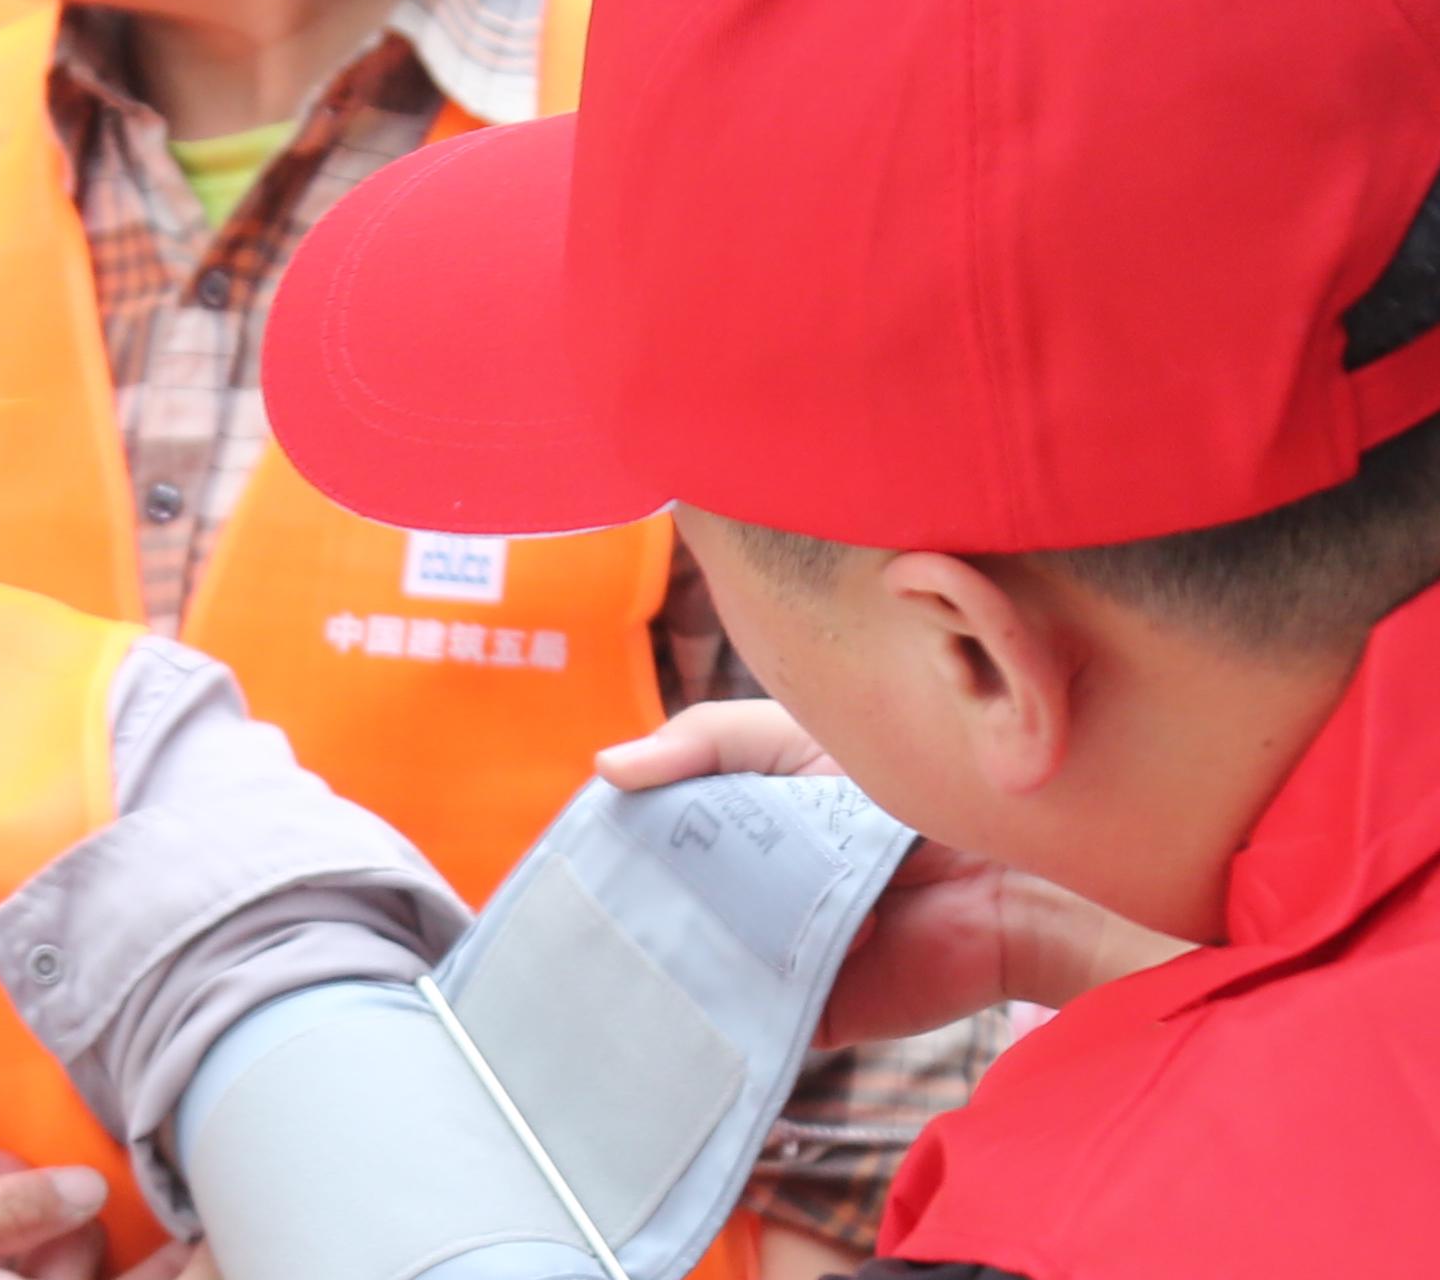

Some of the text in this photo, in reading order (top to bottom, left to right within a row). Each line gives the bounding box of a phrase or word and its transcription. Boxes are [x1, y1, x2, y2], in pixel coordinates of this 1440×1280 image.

[324, 611, 569, 671] 中国建筑五局
